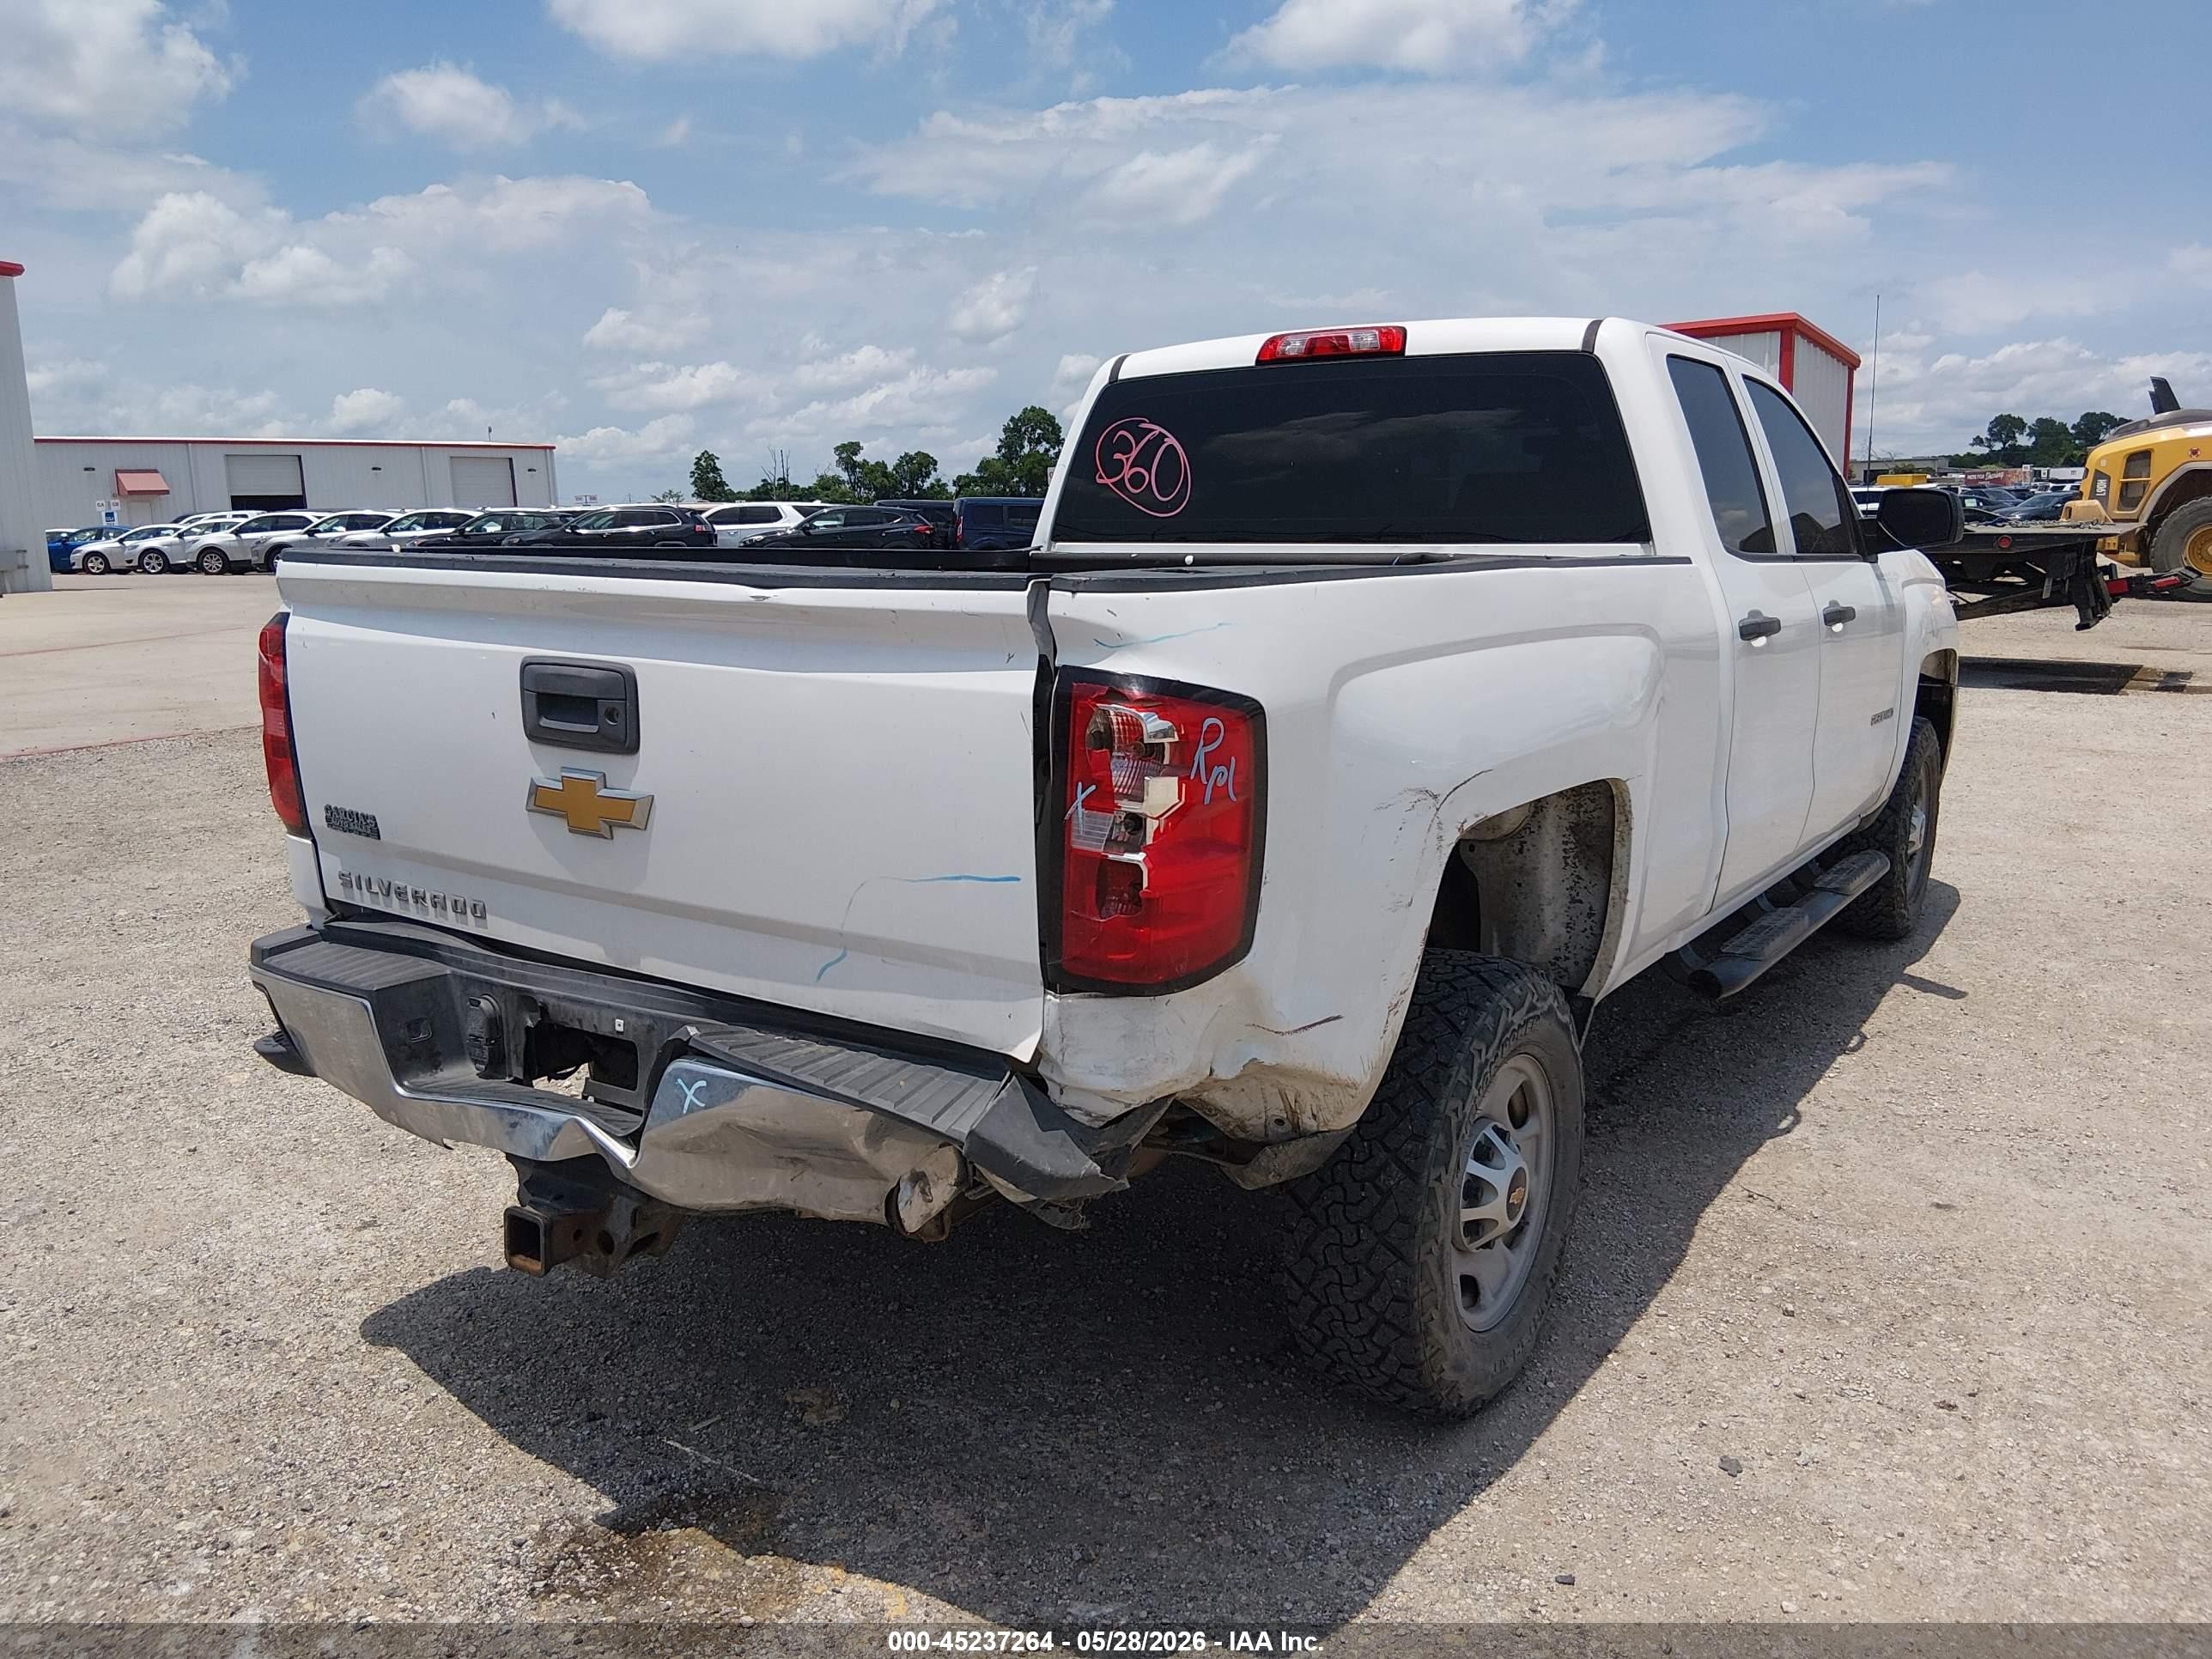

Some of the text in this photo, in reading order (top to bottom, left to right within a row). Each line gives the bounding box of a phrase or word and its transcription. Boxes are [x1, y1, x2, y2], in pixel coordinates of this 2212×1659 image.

[1095, 429, 1187, 502] 360
[2095, 479, 2108, 496] L90H
[338, 869, 488, 921] SILVERADO
